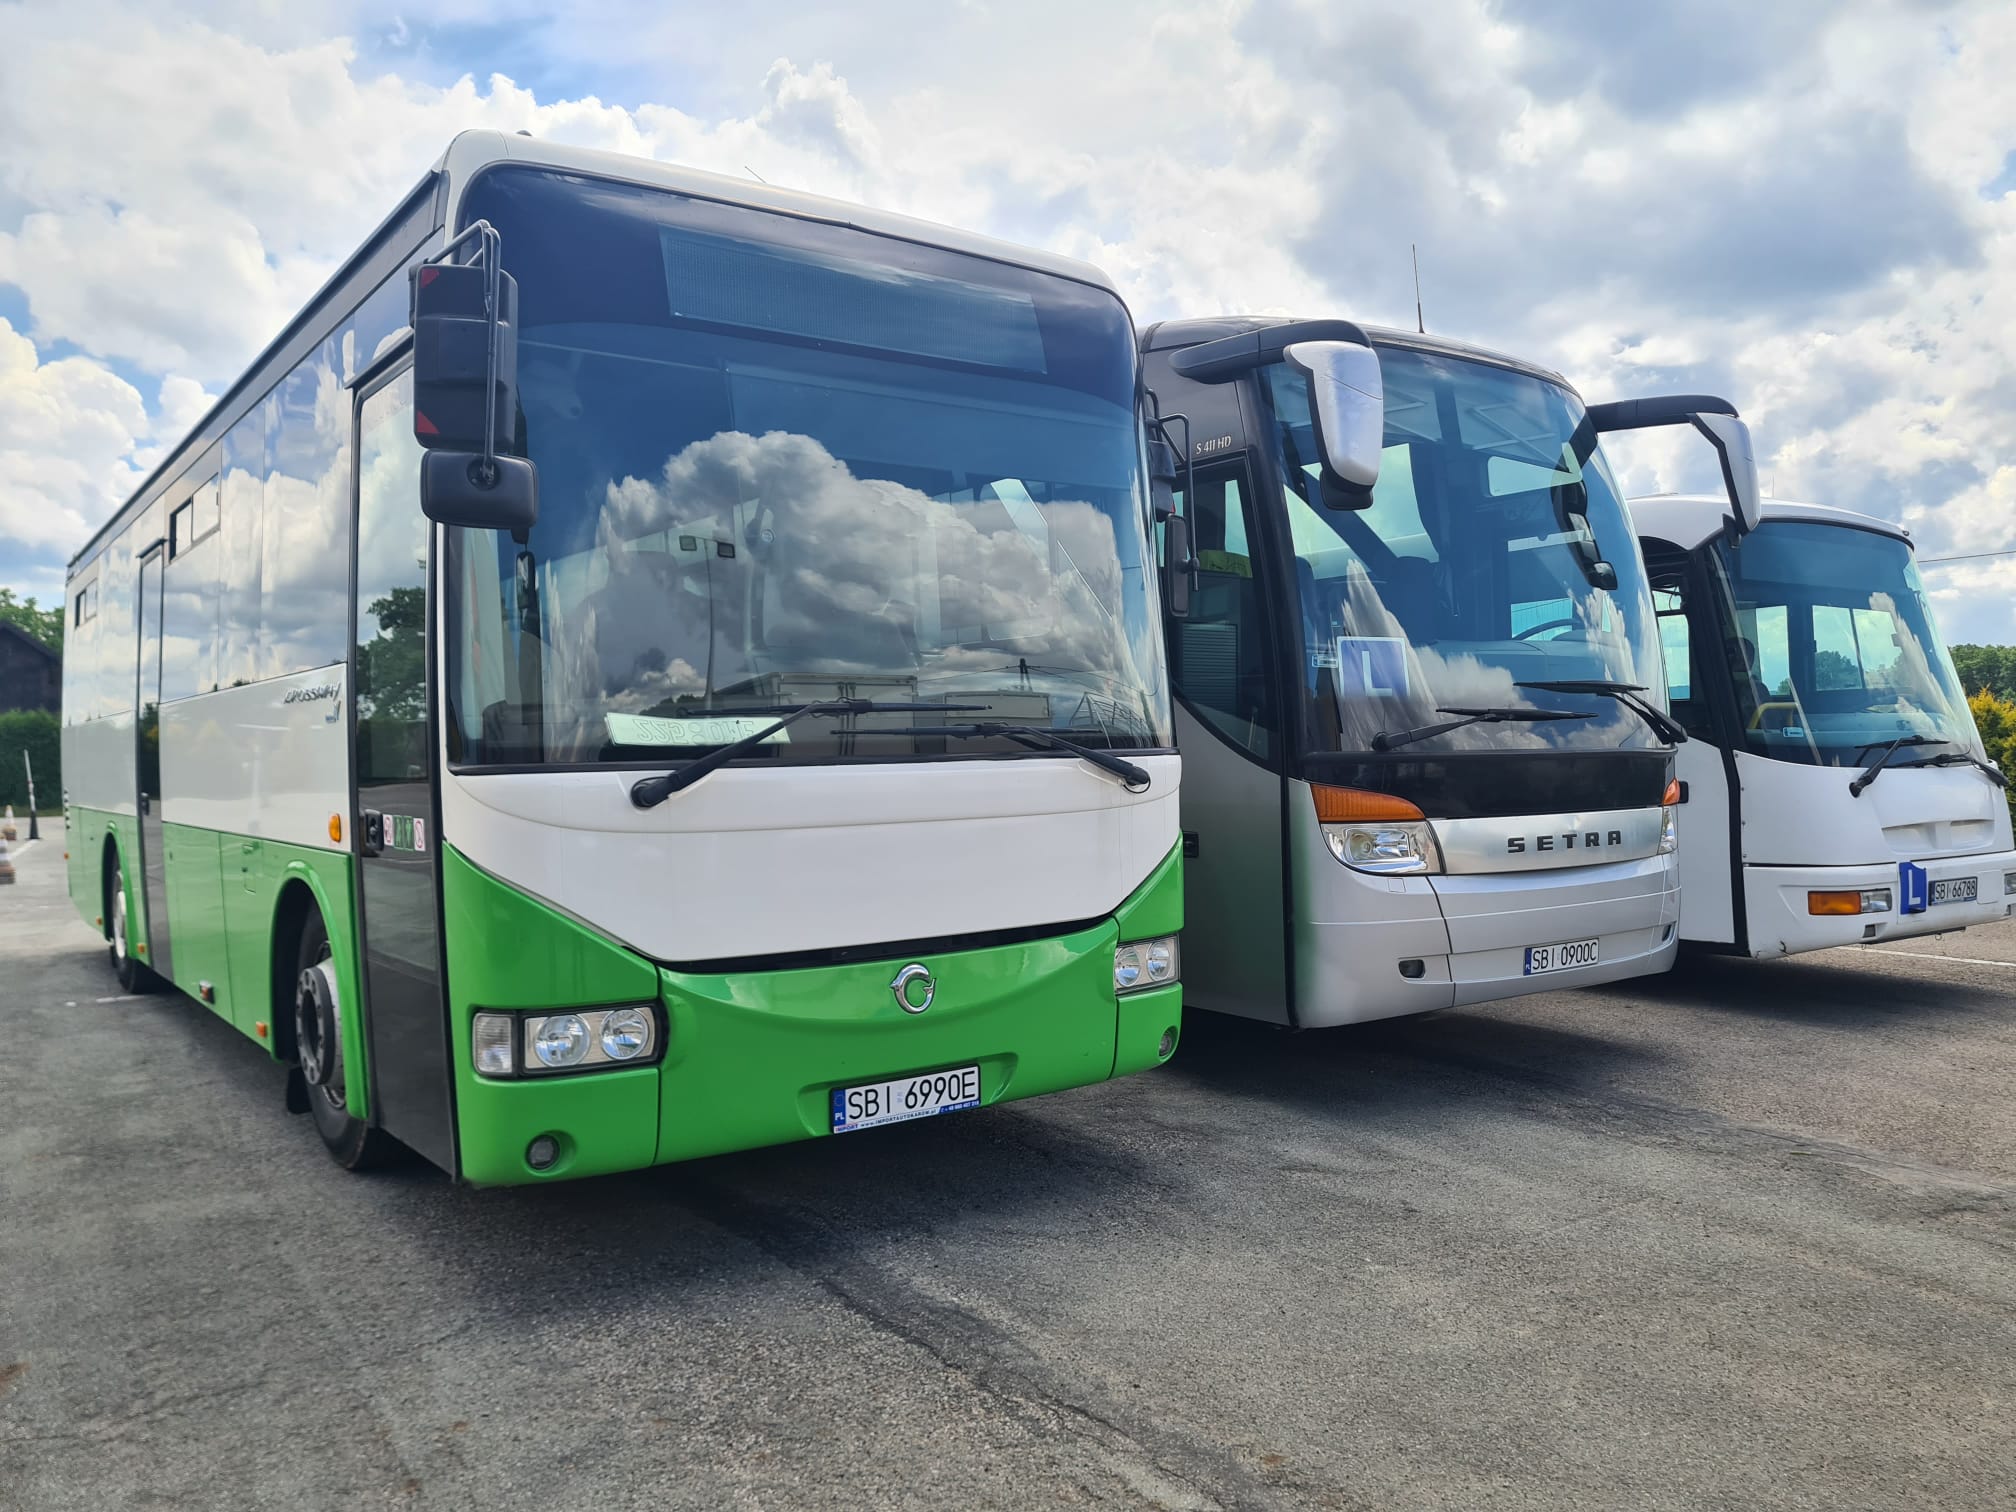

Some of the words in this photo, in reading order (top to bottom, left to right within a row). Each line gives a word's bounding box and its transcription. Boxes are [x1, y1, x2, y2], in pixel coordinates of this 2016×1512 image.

[1196, 443, 1202, 455] S
[1203, 439, 1216, 452] 411
[1217, 435, 1232, 449] HD
[1361, 650, 1393, 697] L
[1507, 830, 1622, 854] SETRA
[1908, 869, 1921, 906] L
[1935, 883, 1949, 900] SBI
[1532, 947, 1555, 970] SBI
[1560, 941, 1598, 966] 0900C
[834, 1112, 845, 1121] PL
[848, 1085, 891, 1120] SBI
[905, 1070, 976, 1109] 6990E
